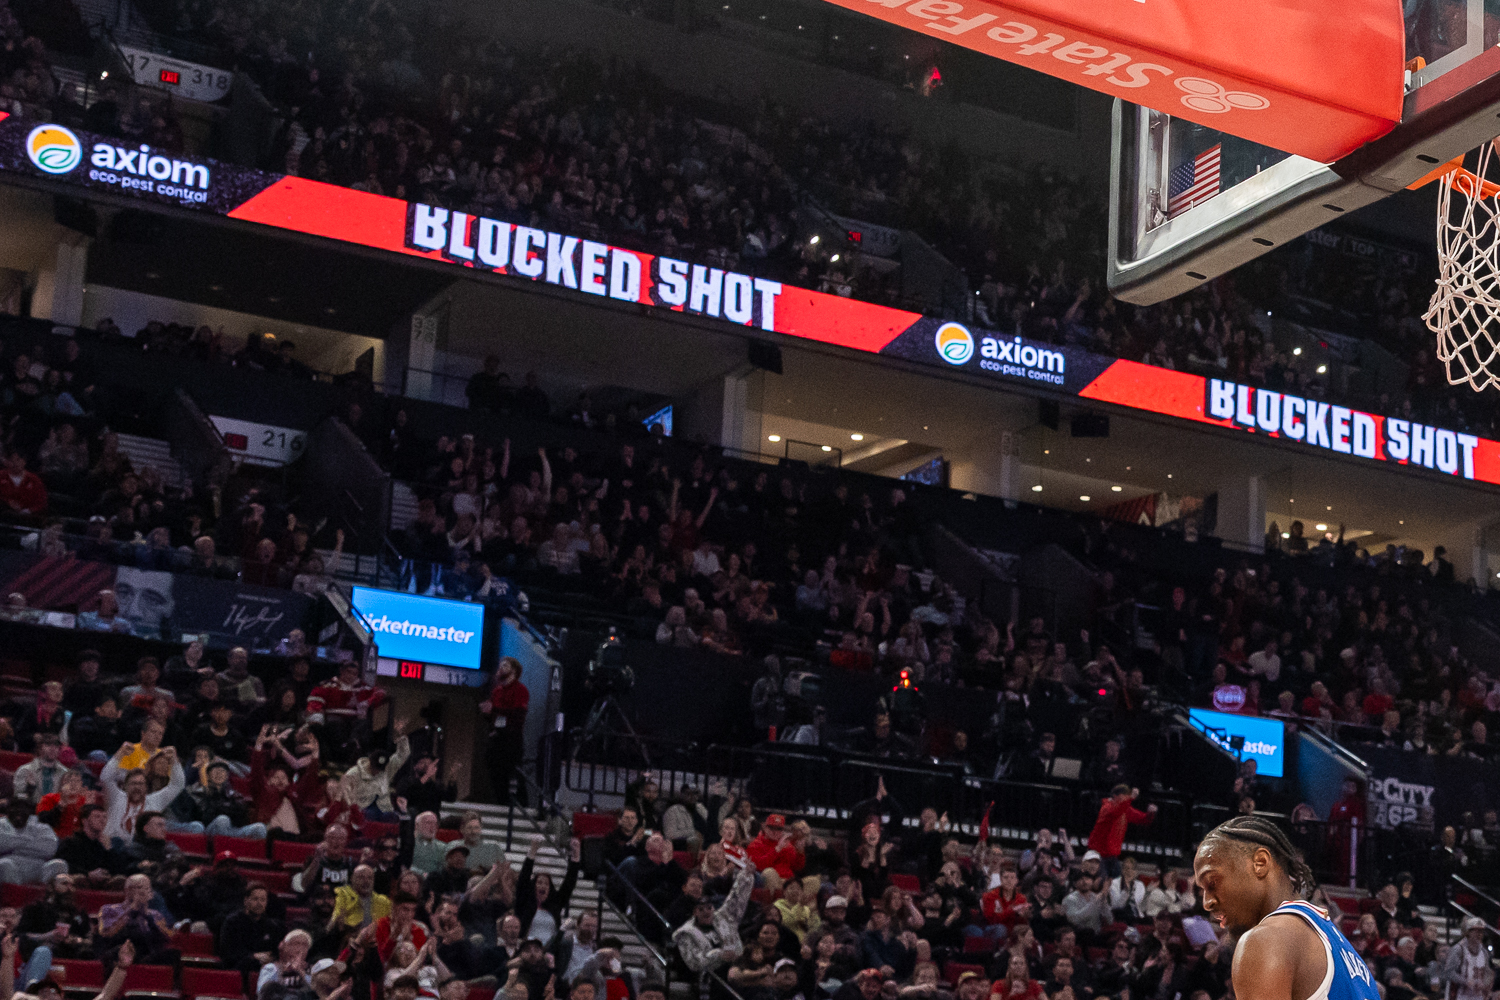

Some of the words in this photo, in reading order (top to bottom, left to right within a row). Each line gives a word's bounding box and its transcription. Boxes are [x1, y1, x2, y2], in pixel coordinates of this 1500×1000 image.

[192, 69, 228, 90] 318
[91, 143, 210, 189] axiom
[156, 184, 208, 203] control
[413, 203, 642, 302] BLOCKED
[658, 256, 782, 331] SHOT
[980, 336, 1065, 373] axiom
[1028, 370, 1064, 384] control
[262, 429, 300, 449] 216
[1210, 378, 1376, 459] BLOCKED
[1387, 417, 1478, 480] SHOT
[400, 662, 422, 679] EXIT
